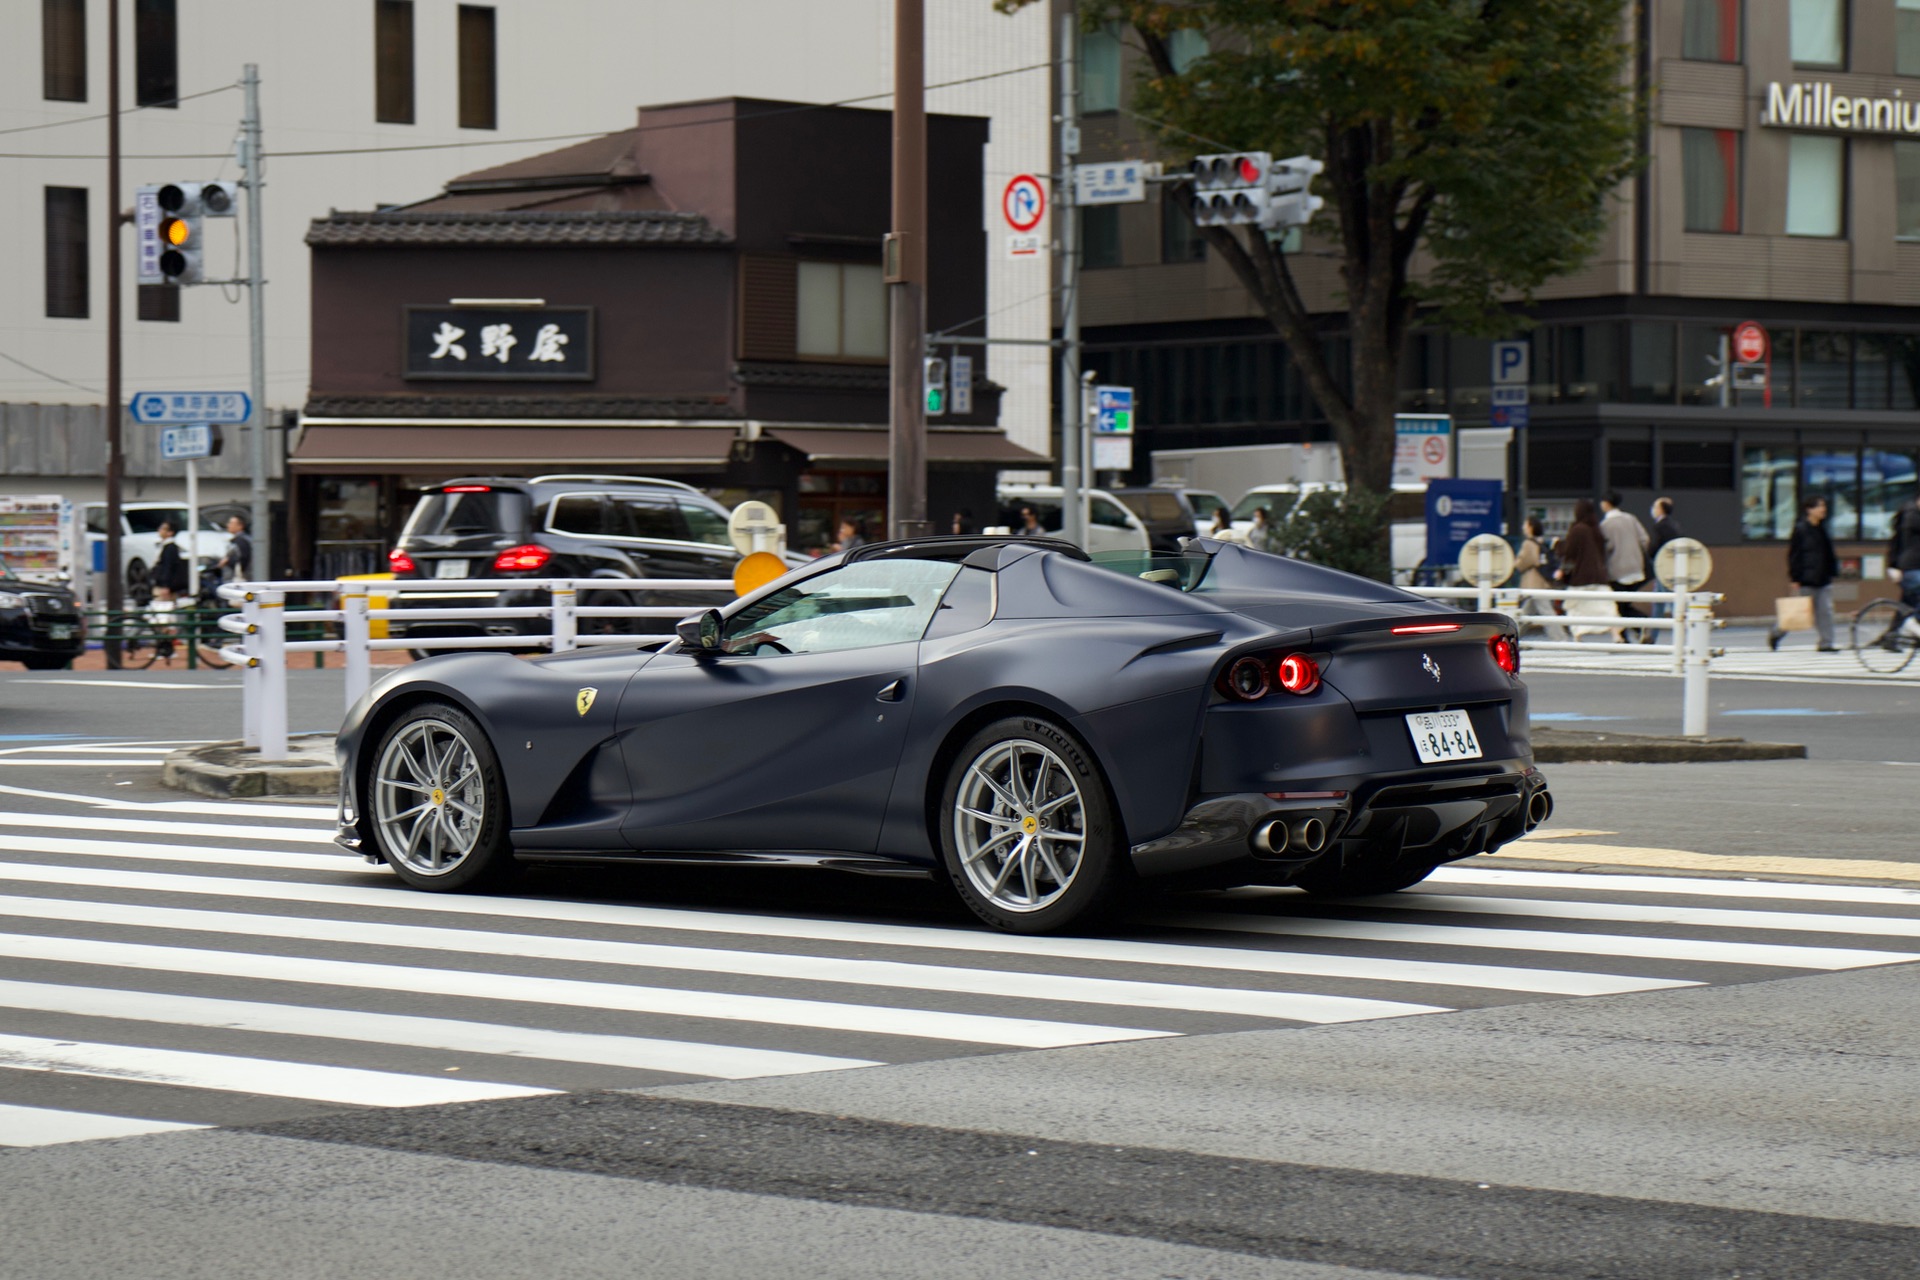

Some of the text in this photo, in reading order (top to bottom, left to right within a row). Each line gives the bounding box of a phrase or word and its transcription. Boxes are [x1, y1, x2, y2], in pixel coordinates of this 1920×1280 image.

[1768, 81, 1920, 132] Millenniu
[429, 321, 569, 363] 大野屋
[1501, 347, 1522, 379] P
[1423, 714, 1457, 729] 品川 333
[1039, 726, 1087, 775] MICHELIN
[1428, 729, 1477, 757] 84-84
